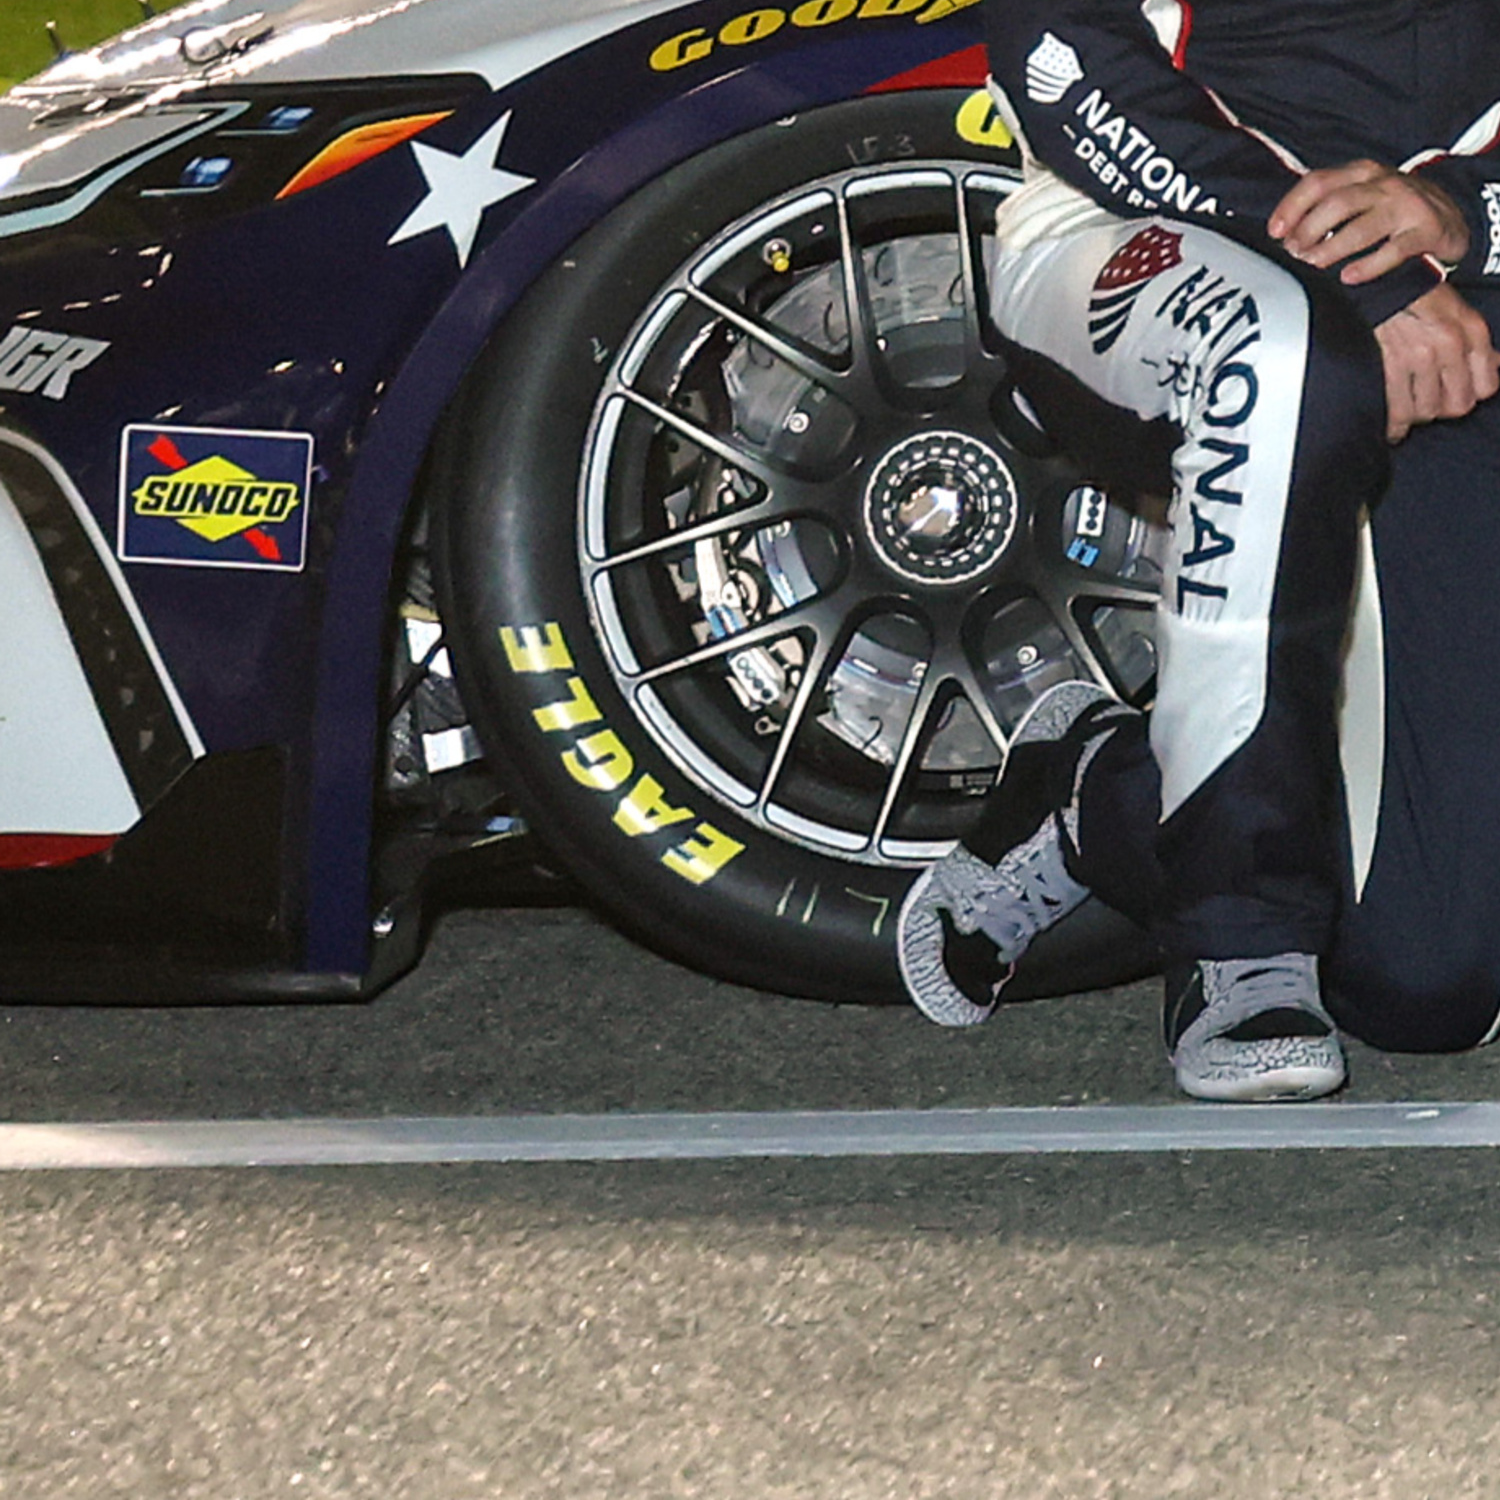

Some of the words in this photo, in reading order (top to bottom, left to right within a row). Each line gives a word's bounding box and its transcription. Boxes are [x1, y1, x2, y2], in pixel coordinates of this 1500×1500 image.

[1074, 137, 1130, 194] DEBT
[1076, 89, 1234, 217] NATIONA
[140, 480, 293, 518] SUNOCO
[1155, 265, 1262, 617] NATIONAL
[499, 621, 747, 885] EAGLE
